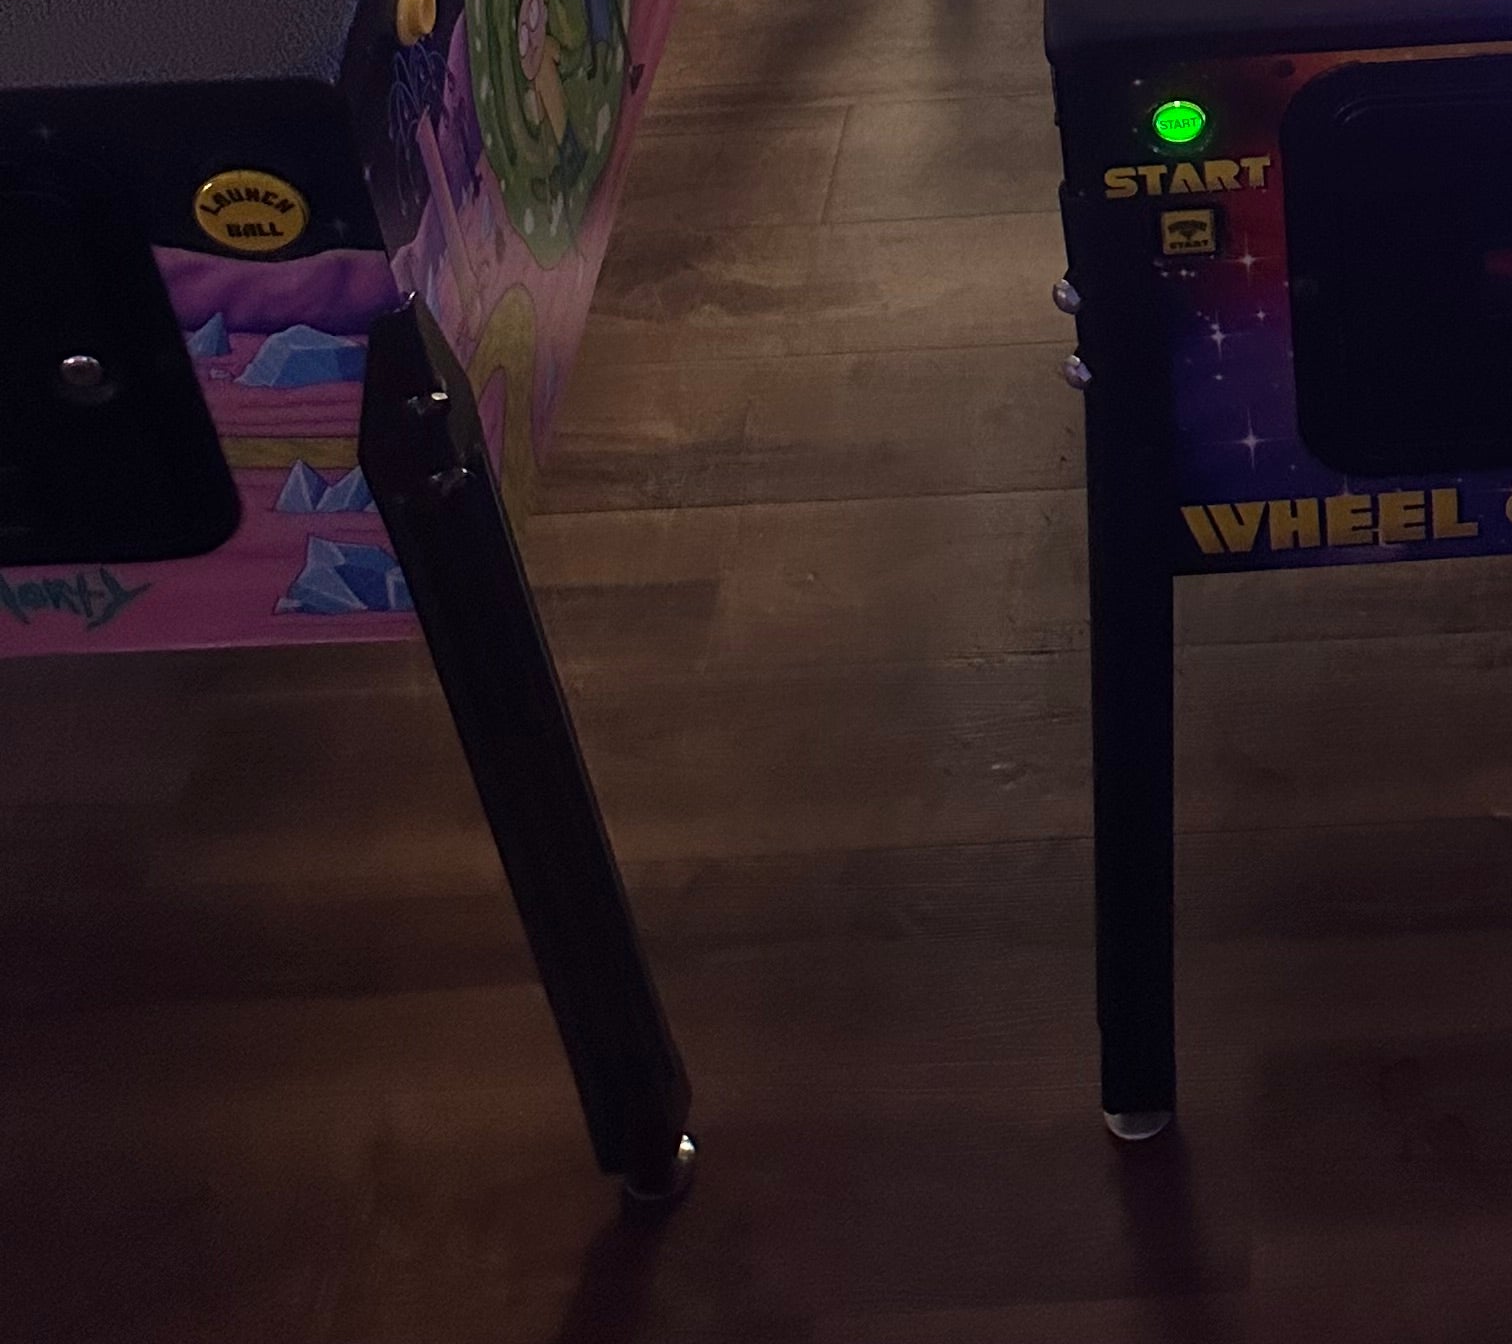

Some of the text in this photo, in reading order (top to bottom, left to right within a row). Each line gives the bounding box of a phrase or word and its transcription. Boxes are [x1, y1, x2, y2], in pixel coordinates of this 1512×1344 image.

[1159, 117, 1199, 130] START
[1104, 156, 1271, 199] START
[200, 187, 294, 217] LAUNCH
[226, 221, 285, 238] BALL
[1169, 239, 1209, 250] START
[1180, 487, 1479, 554] WHEEL
